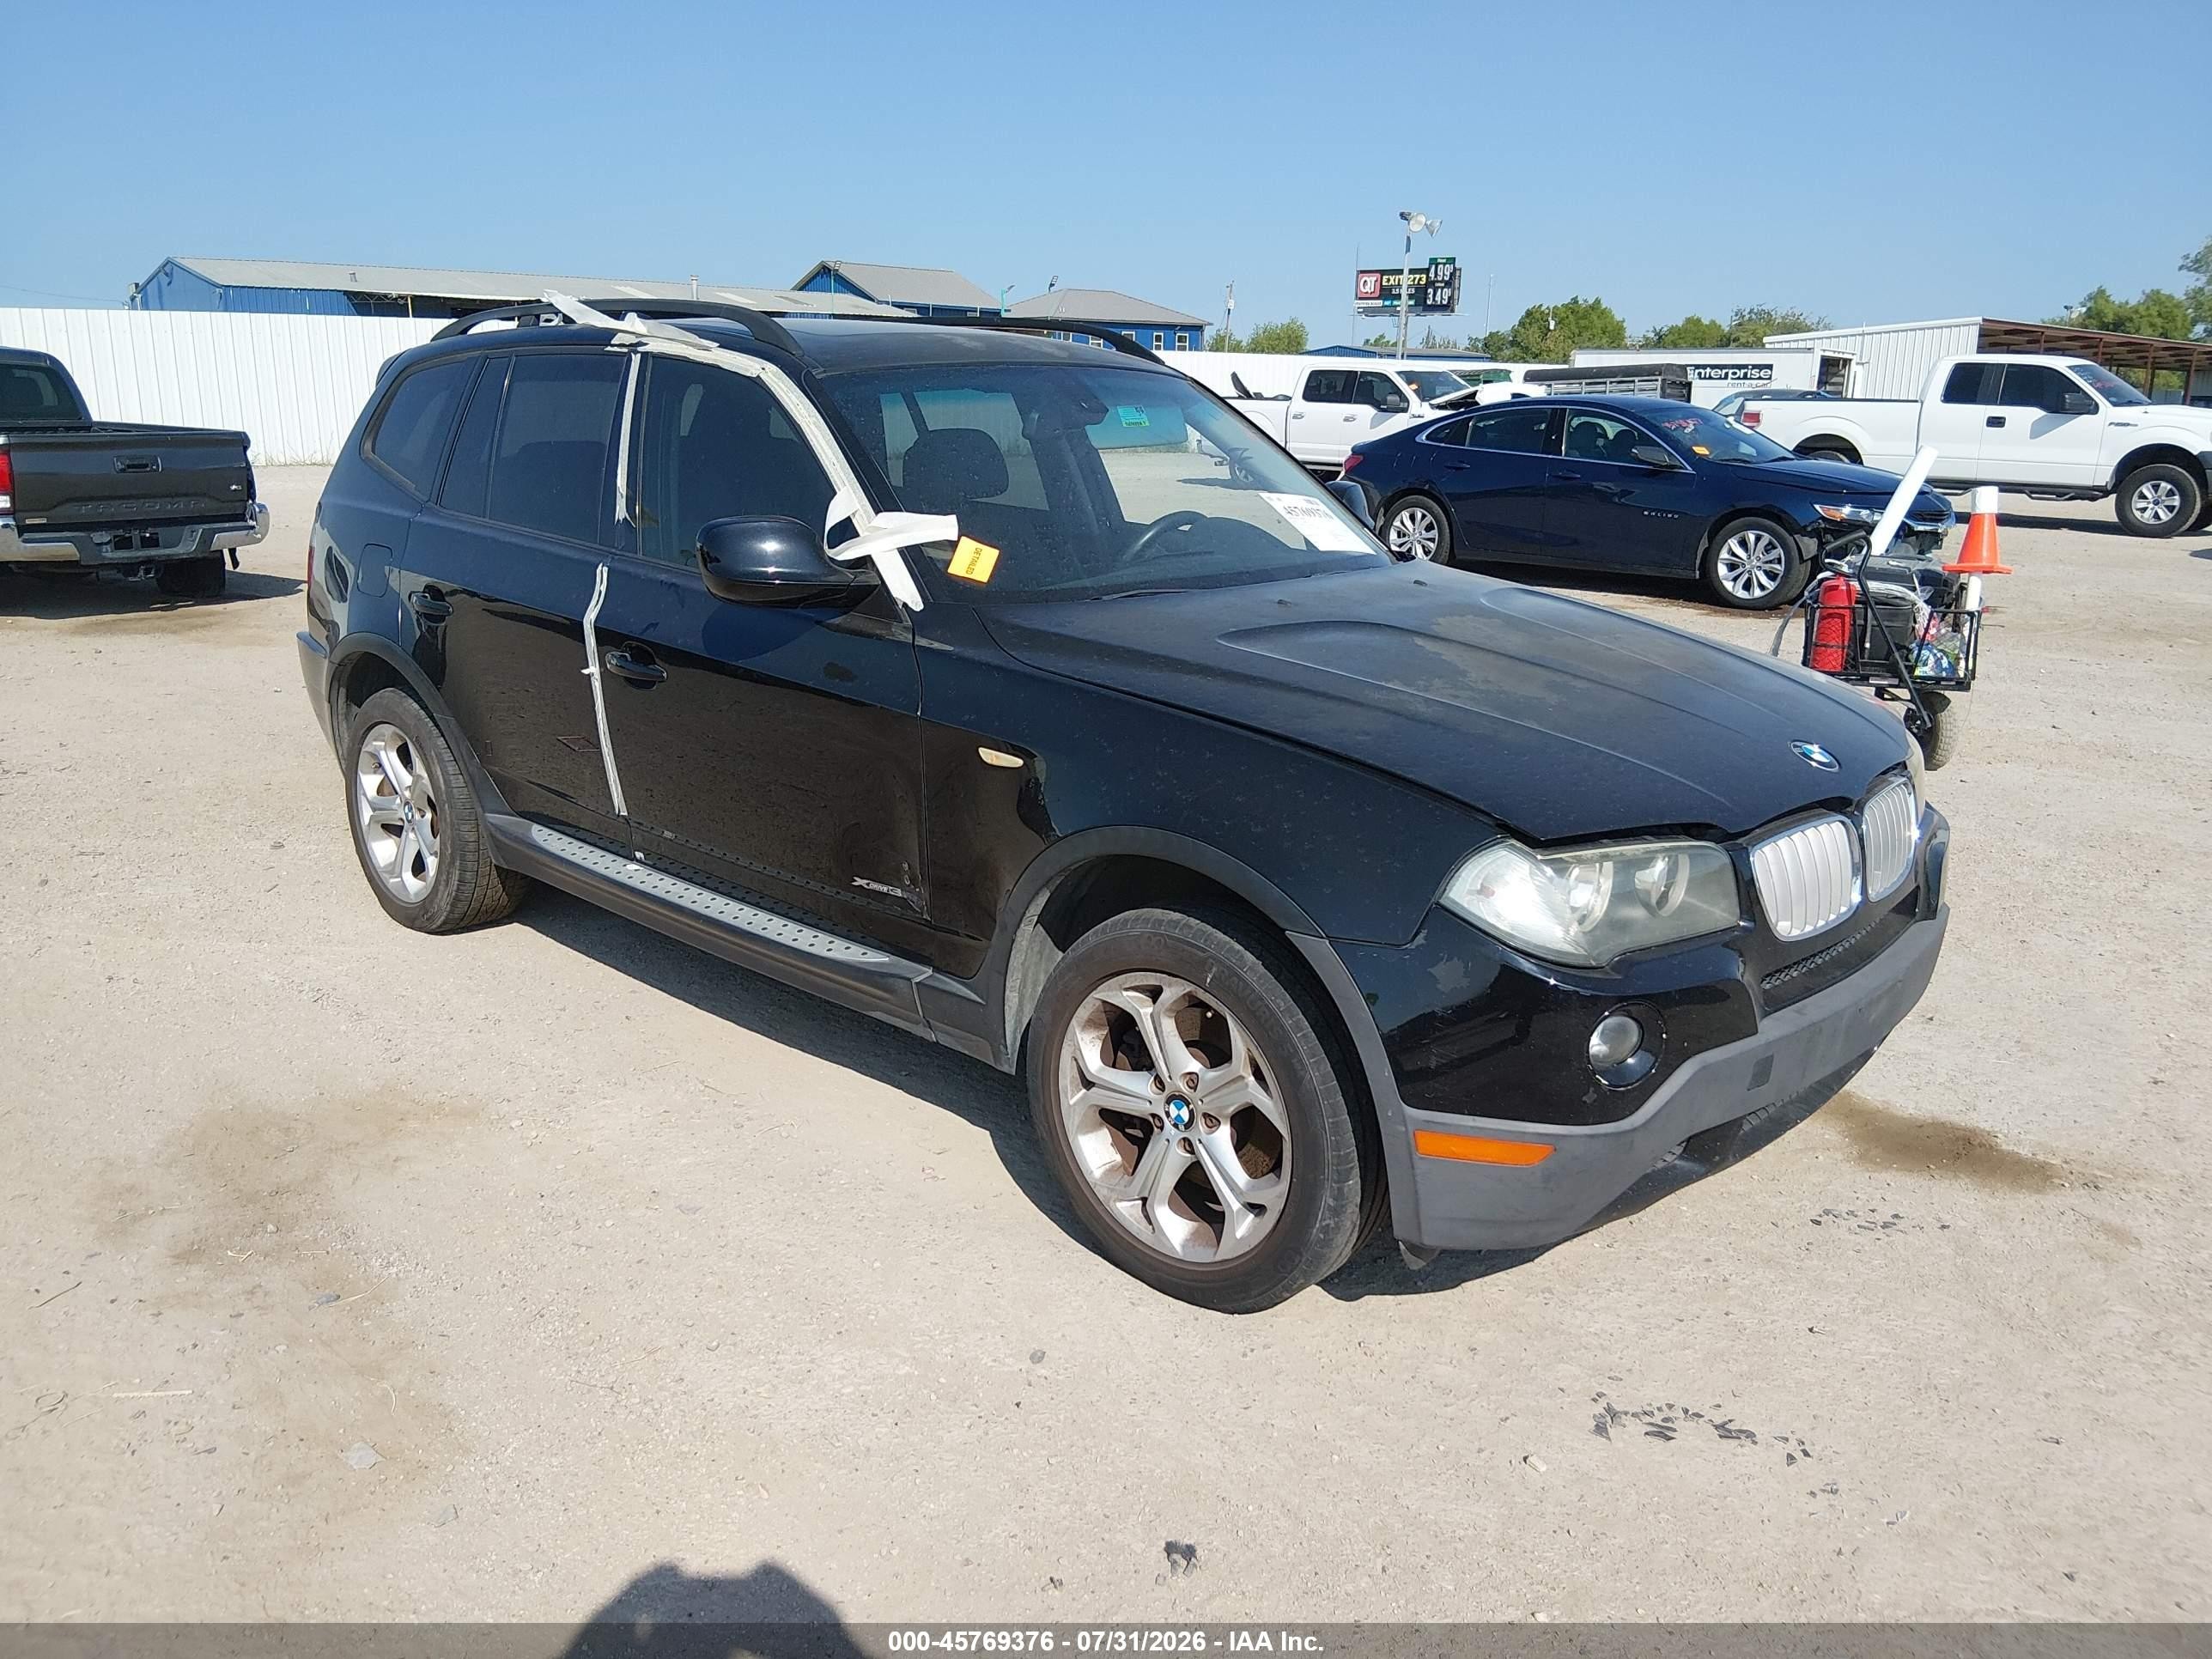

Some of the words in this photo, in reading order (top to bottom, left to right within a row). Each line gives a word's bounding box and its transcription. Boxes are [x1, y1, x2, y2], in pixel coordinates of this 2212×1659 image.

[1359, 276, 1376, 294] QT
[1407, 274, 1426, 284] 273
[73, 501, 205, 514] TACOMA
[965, 547, 982, 575] DETAILED
